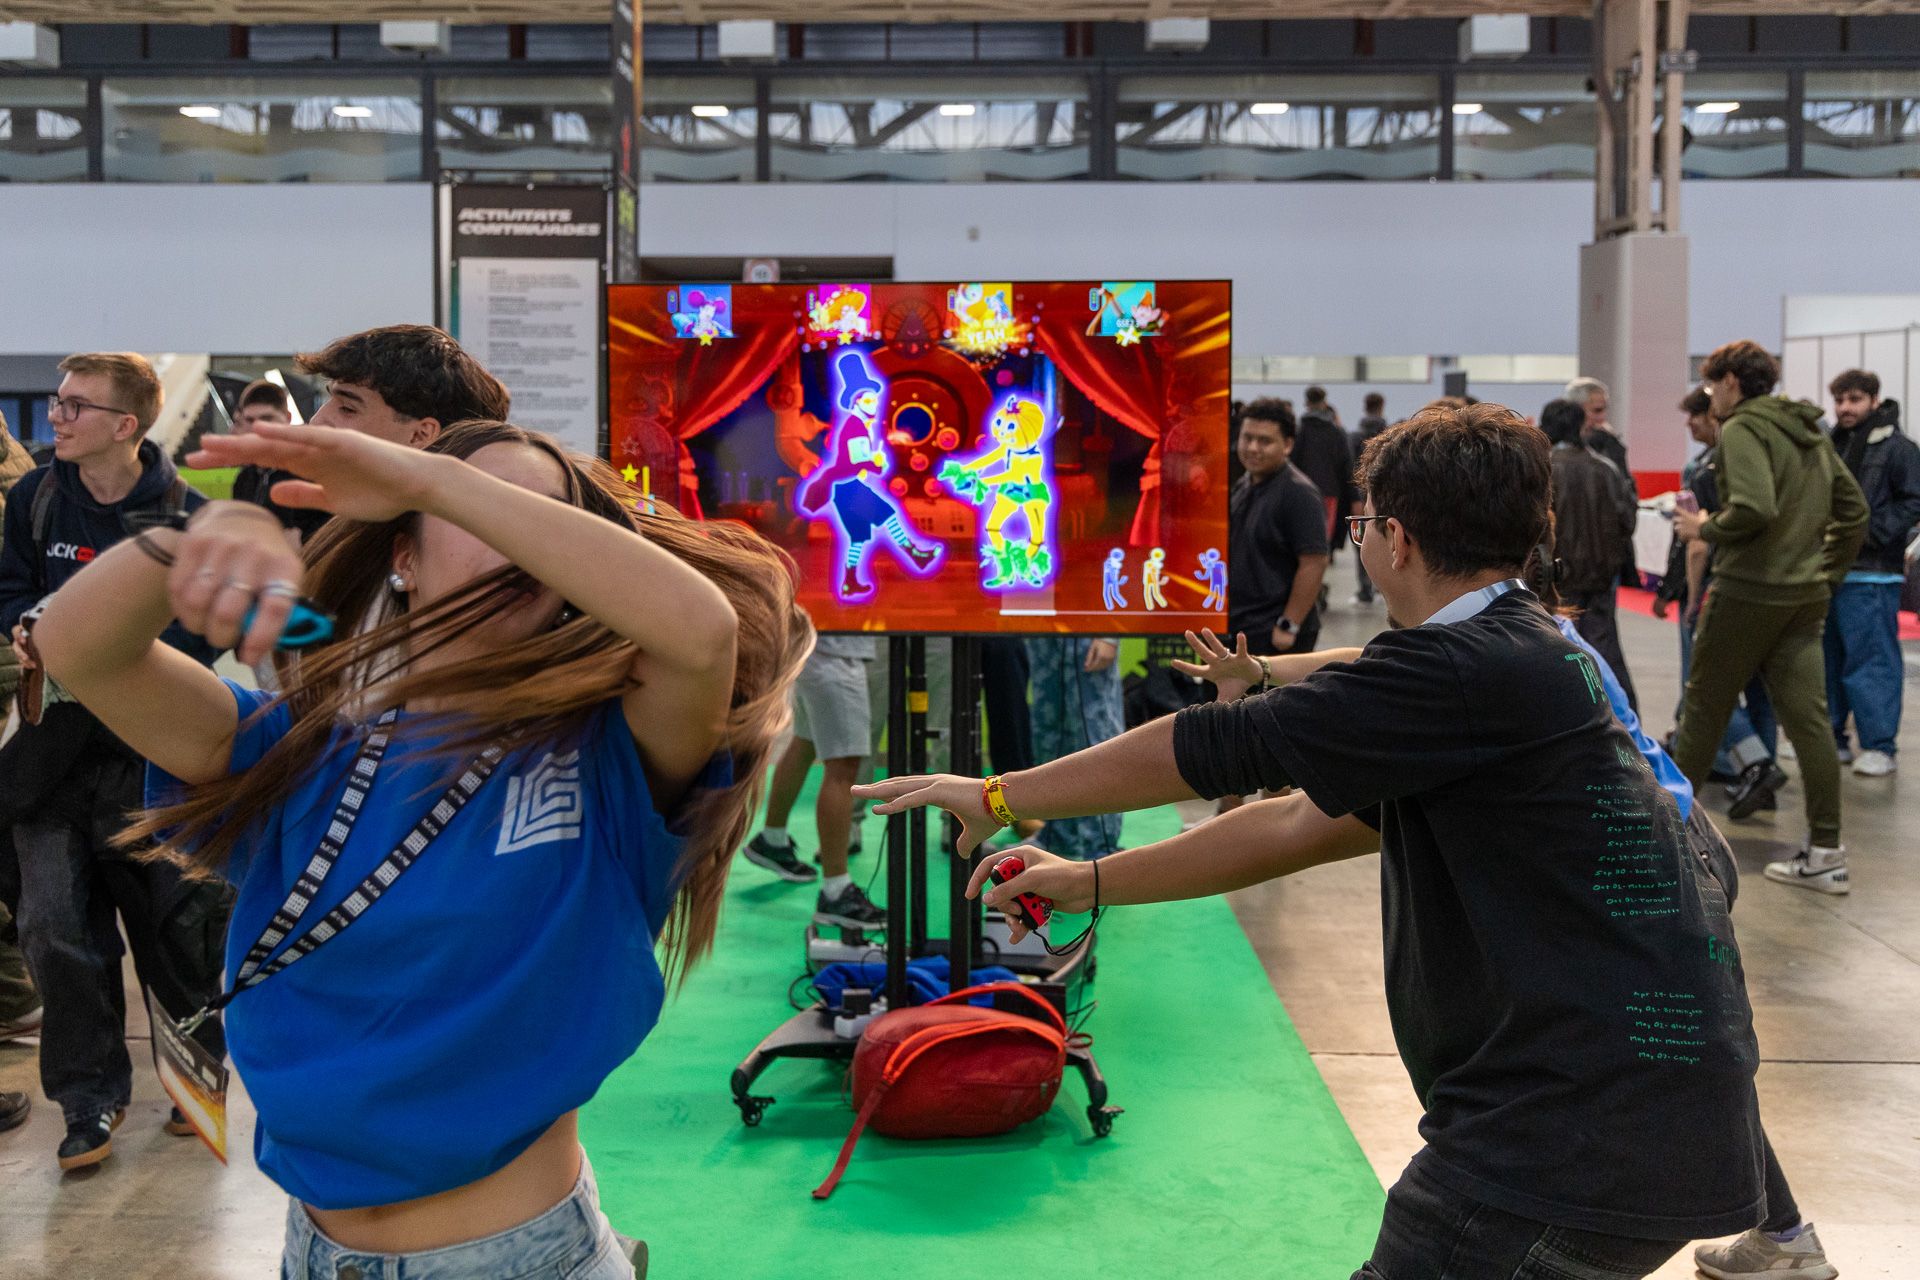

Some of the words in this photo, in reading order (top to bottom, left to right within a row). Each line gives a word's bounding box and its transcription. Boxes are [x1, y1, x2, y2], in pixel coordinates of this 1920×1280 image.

[458, 208, 572, 222] ACTIVITATS
[458, 222, 601, 237] CONTINUADES
[1597, 855, 1616, 863] Sep
[1633, 991, 1650, 999] Apr
[1625, 1005, 1642, 1014] May
[1663, 1007, 1703, 1017] Birmingham
[1635, 1021, 1651, 1030] May
[1670, 1023, 1700, 1033] Glasgow
[1629, 1035, 1646, 1044] May
[1665, 1038, 1707, 1046] Manchester
[1638, 1052, 1654, 1060] May
[1673, 1055, 1701, 1065] Cologne
